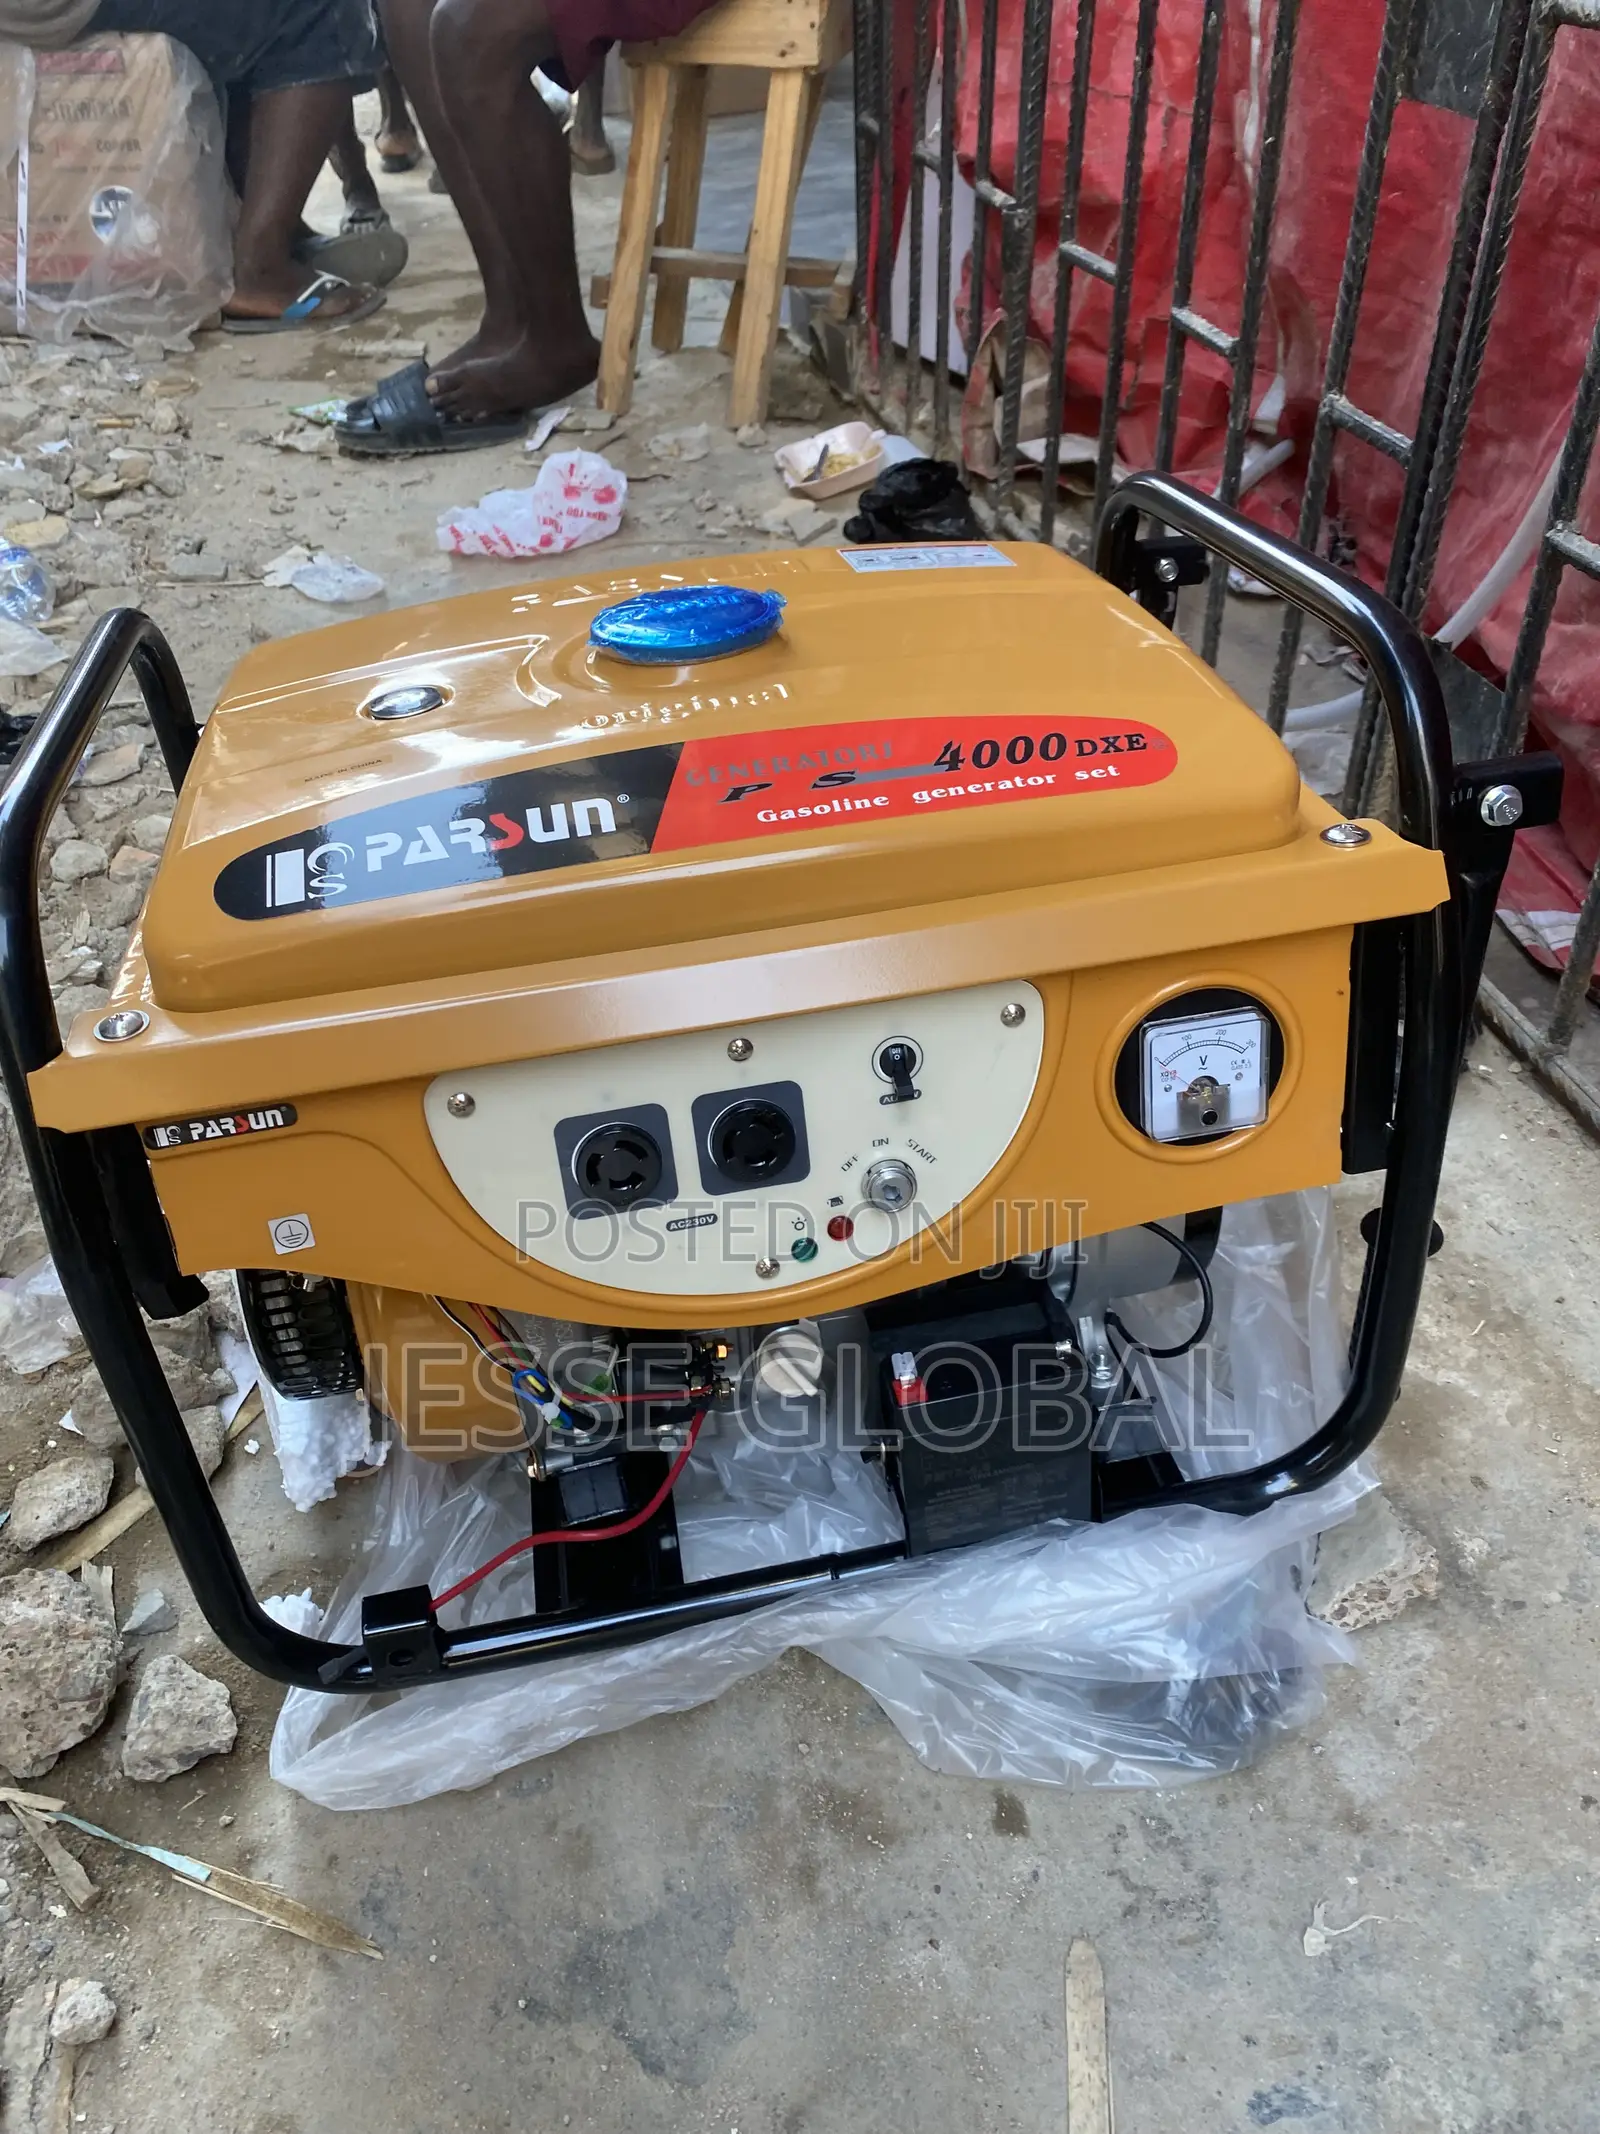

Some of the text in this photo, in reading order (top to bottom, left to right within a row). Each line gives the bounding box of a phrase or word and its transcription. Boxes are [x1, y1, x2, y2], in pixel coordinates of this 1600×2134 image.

[933, 732, 1067, 772] 4000
[1074, 733, 1148, 757] DXE
[756, 765, 1121, 823] Gasoline generator set
[1181, 1034, 1192, 1042] 100
[1199, 1054, 1208, 1066] V
[872, 1137, 889, 1148] ON
[907, 1138, 938, 1164] START
[841, 1155, 859, 1172] OFF
[669, 1214, 715, 1230] AC230V
